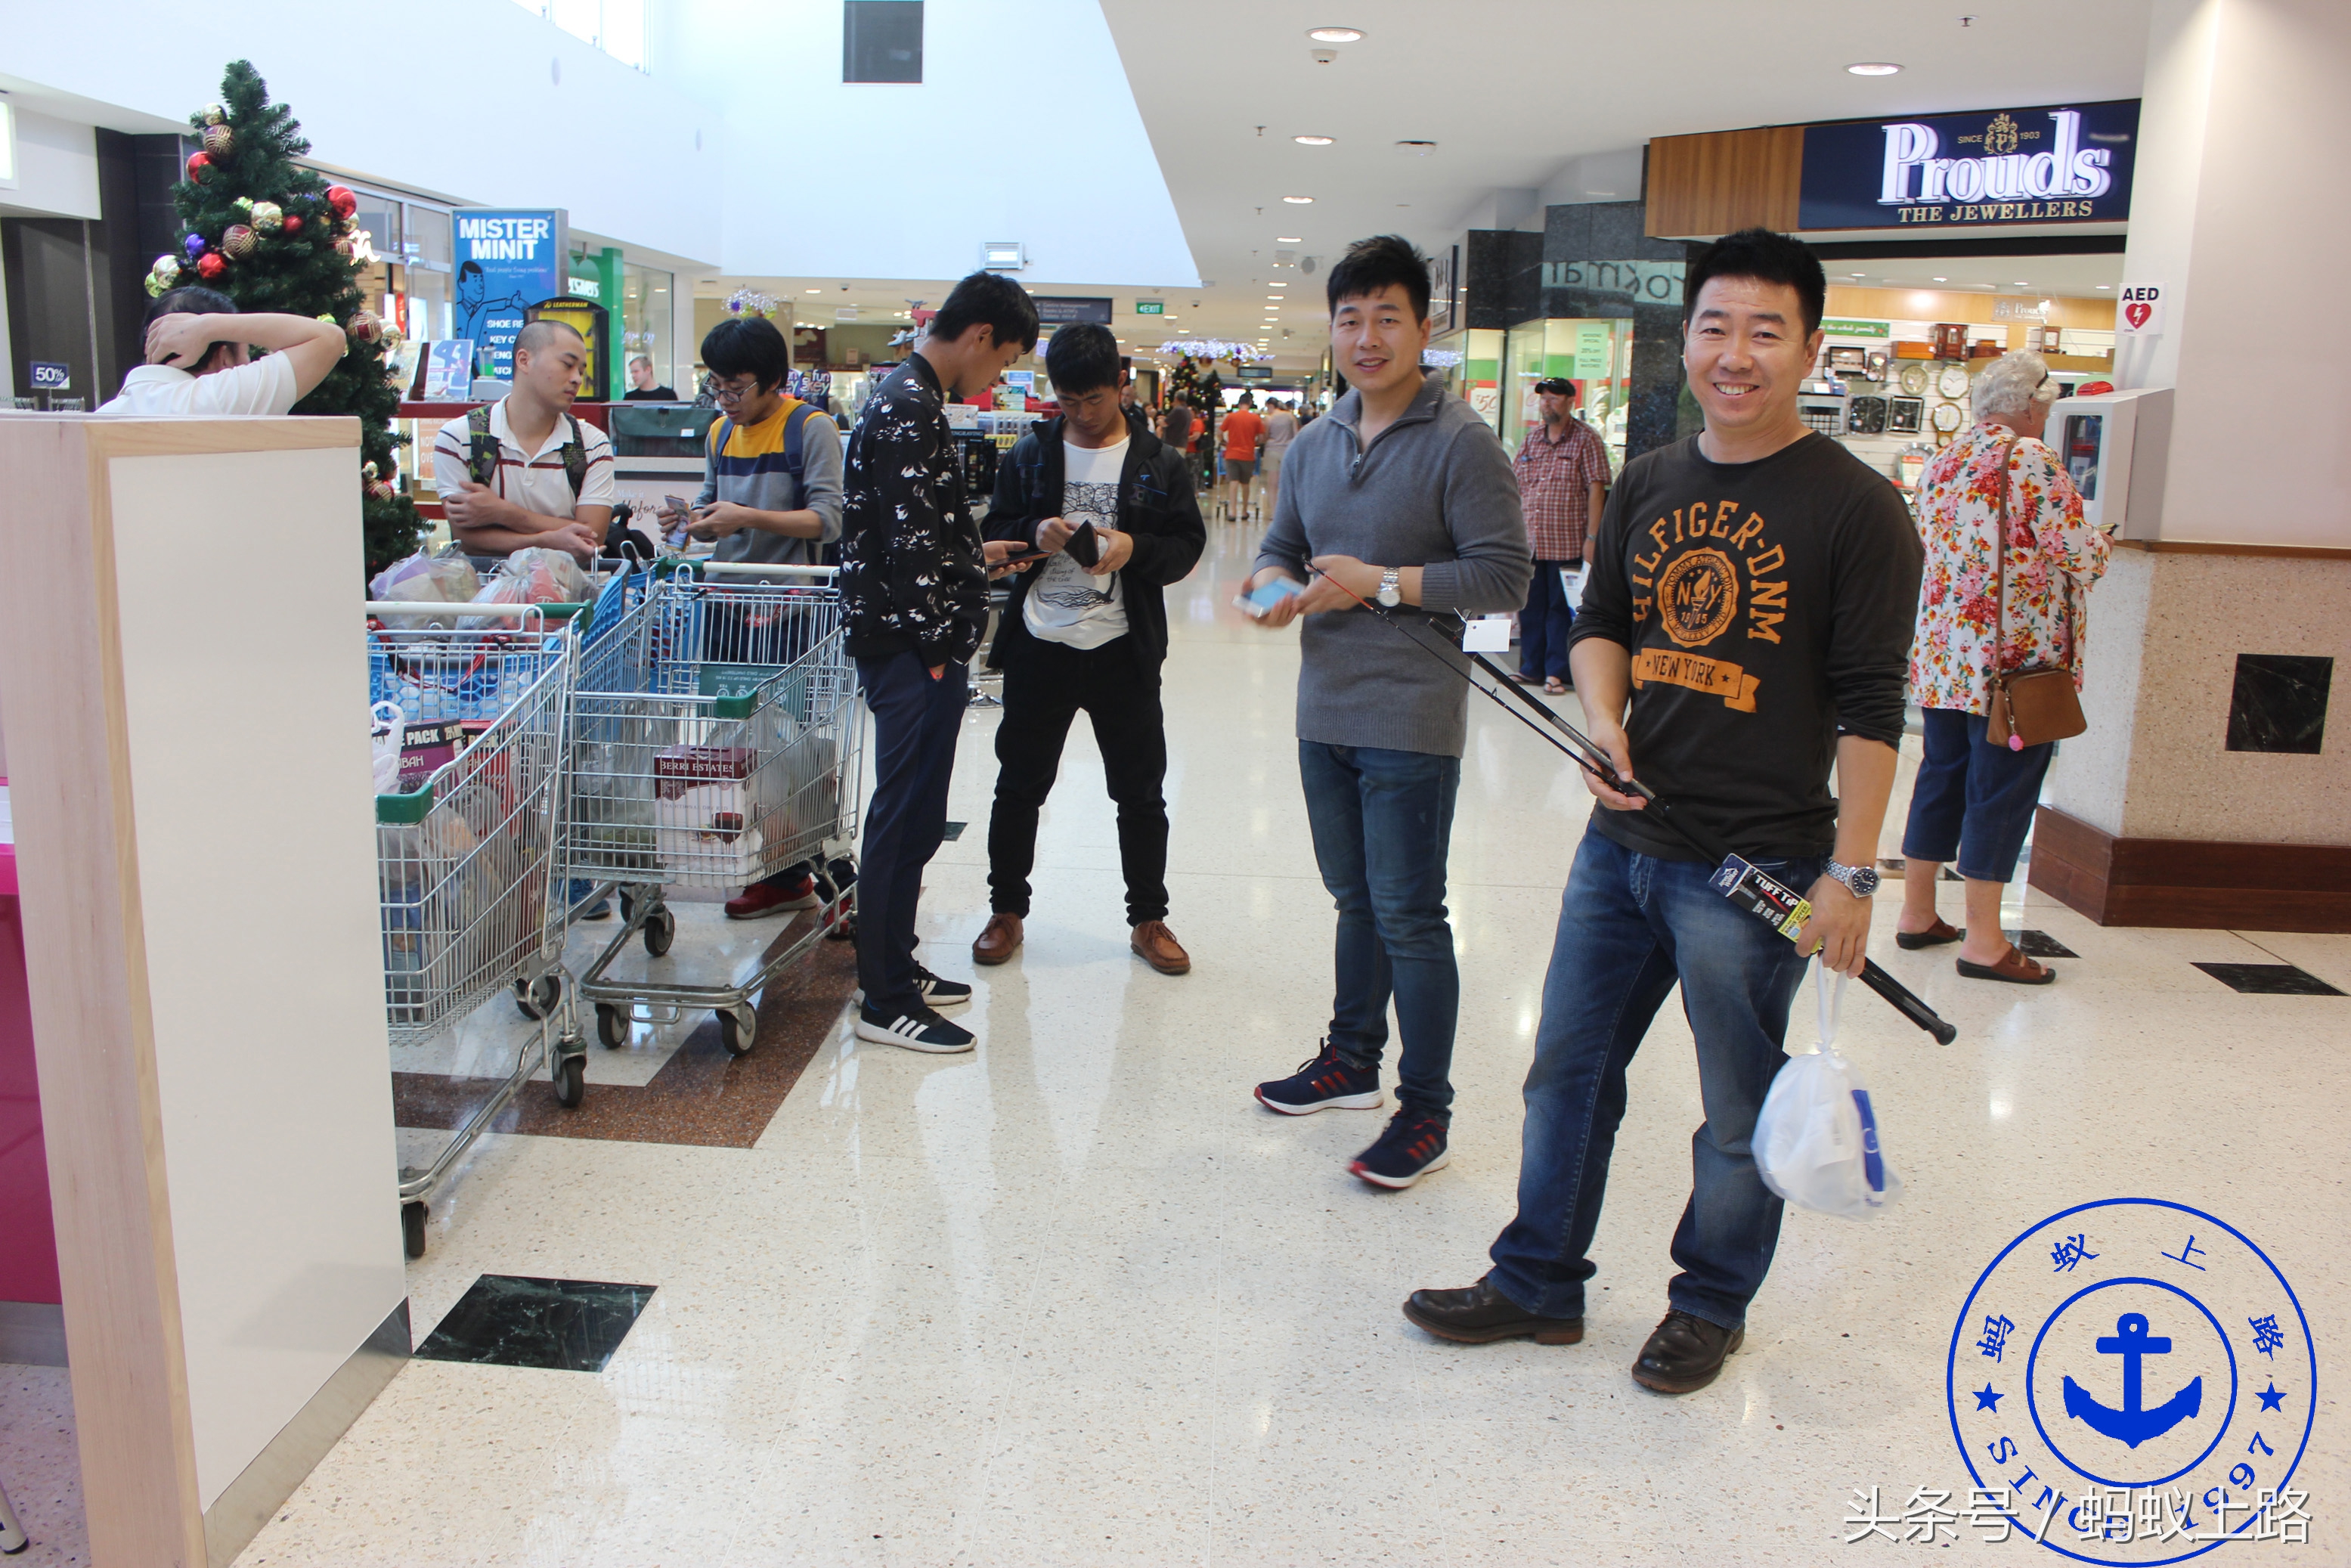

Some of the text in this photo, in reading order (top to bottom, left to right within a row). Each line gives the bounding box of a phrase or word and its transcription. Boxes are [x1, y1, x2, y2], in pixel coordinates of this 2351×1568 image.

[1957, 131, 2040, 144] SINCE 1903
[1877, 110, 2111, 206] Prouds
[1898, 200, 2093, 222] THE JEWELLERS
[460, 218, 550, 239] MISTER
[471, 239, 539, 260] MINIT
[2122, 287, 2160, 301] AED
[1143, 304, 1160, 313] EXIT
[487, 319, 511, 328] SHOE
[490, 336, 507, 344] KEY
[35, 367, 65, 382] 50%
[812, 369, 830, 382] fun
[1653, 654, 1716, 686] NEW YORK
[407, 728, 440, 745] PACK
[661, 761, 733, 773] BERRI ESTATES
[1755, 874, 1783, 896] TUFF
